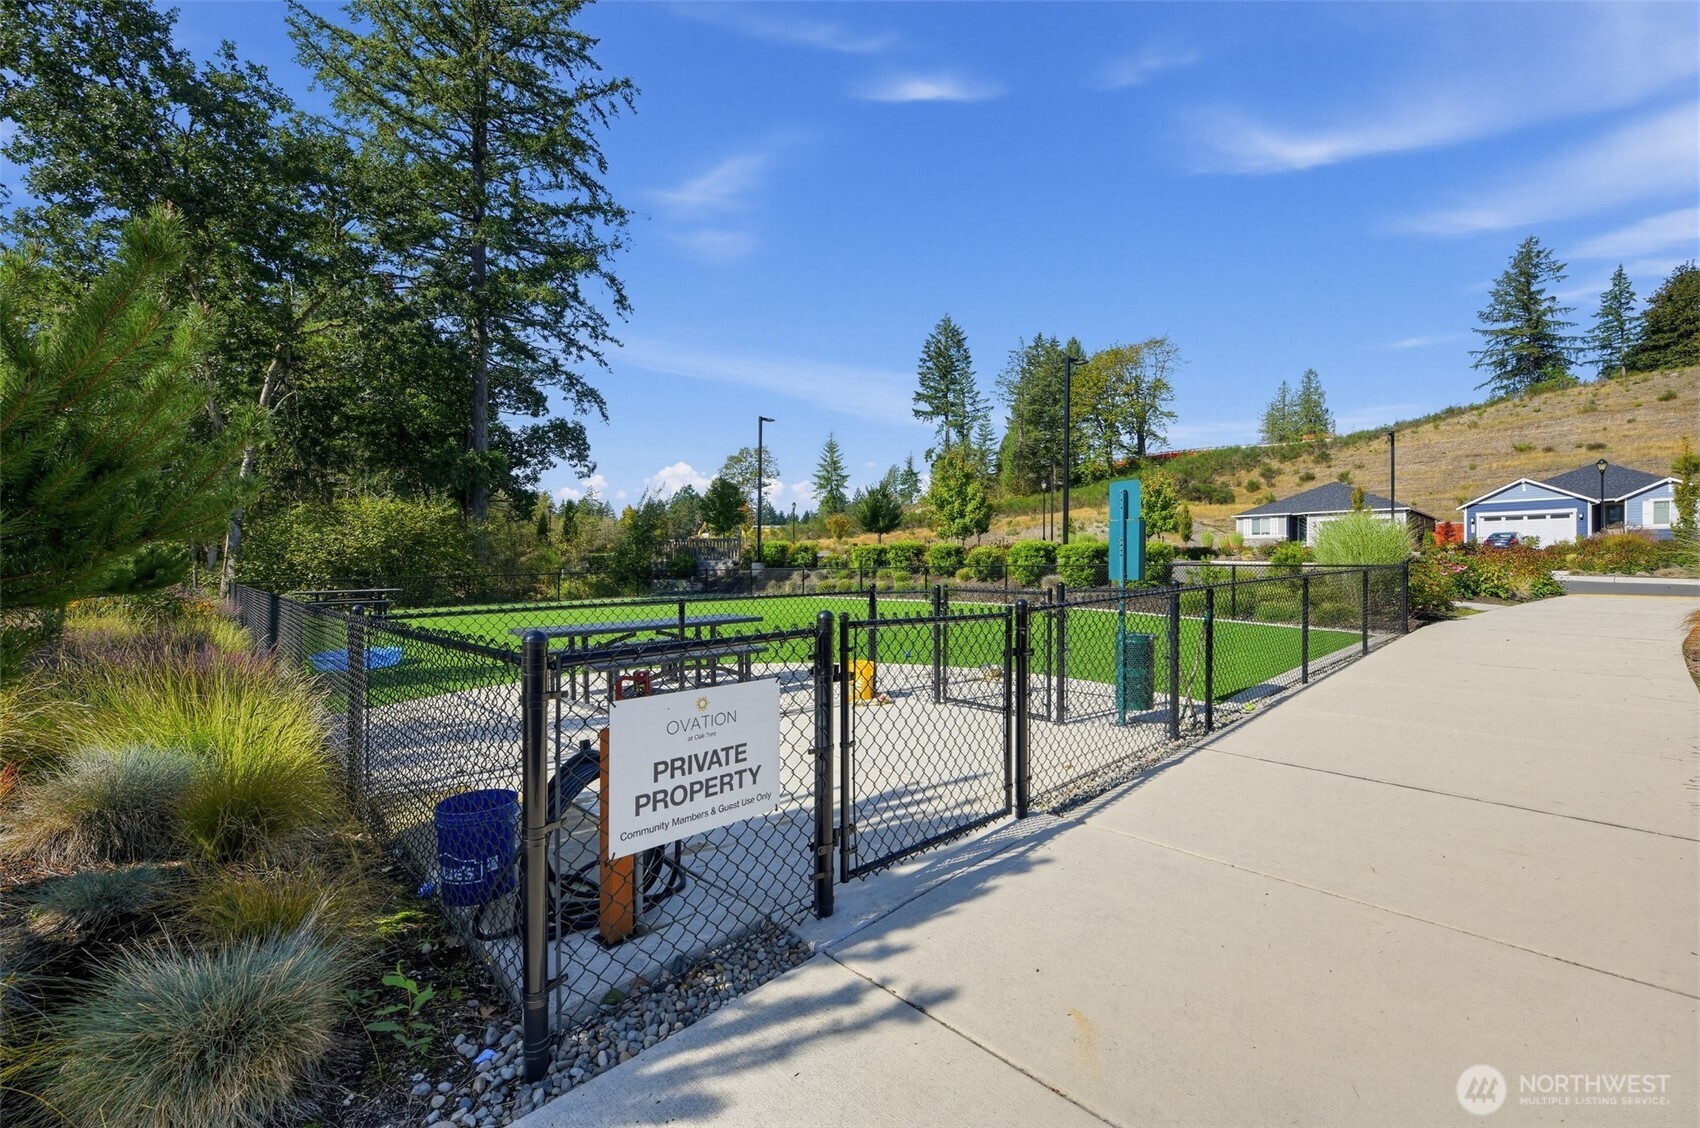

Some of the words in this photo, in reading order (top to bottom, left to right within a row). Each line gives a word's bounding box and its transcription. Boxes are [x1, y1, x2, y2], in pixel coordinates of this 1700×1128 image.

[666, 710, 737, 735] OVATION
[653, 742, 748, 783] PRIVATE
[635, 764, 762, 817] PROPERTY
[620, 820, 670, 842] Community
[710, 807, 717, 816] &
[718, 802, 740, 814] Guest
[741, 797, 755, 808] Use
[756, 791, 772, 803] Only
